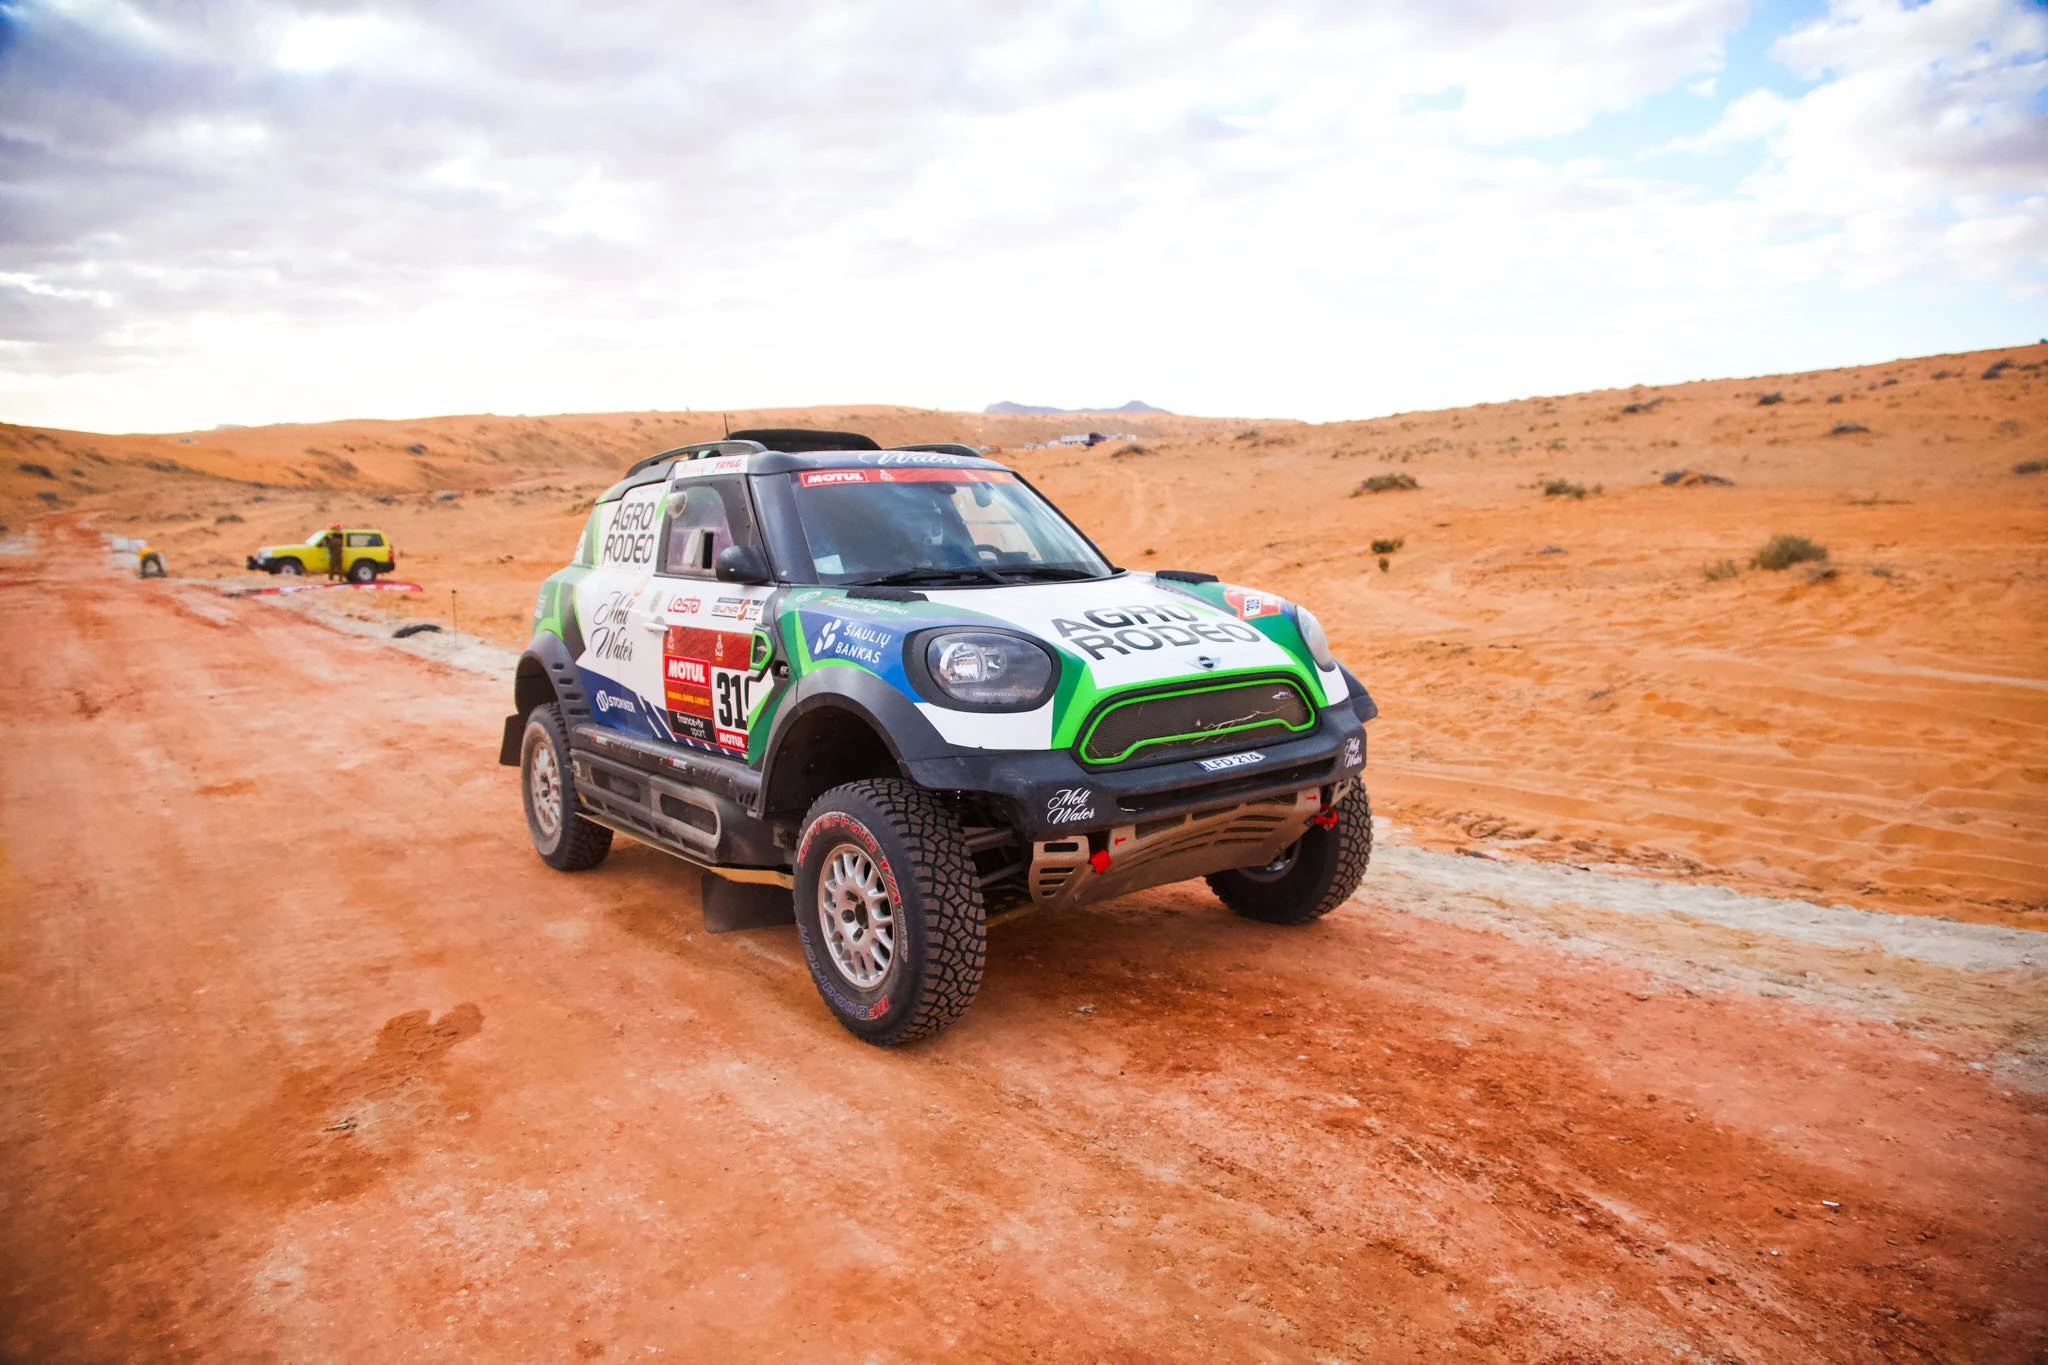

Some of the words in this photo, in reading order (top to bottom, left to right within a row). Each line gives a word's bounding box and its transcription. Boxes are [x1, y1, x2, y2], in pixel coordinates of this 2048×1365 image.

[857, 451, 963, 465] Water
[807, 471, 864, 483] MOTUL
[609, 501, 656, 531] AGRO
[601, 533, 655, 565] RODEO
[1050, 603, 1200, 638] AGRO
[590, 626, 633, 662] Water
[843, 621, 892, 648] ŠIAULIŲ
[1069, 622, 1261, 661] RODEO
[834, 641, 882, 664] BANKAS
[667, 659, 706, 683] MOTUL
[716, 671, 749, 731] 31
[690, 727, 707, 739] sport
[719, 732, 746, 749] MOTUL
[1203, 758, 1234, 769] LFD
[1232, 753, 1260, 764] 214
[1046, 803, 1096, 825] Water
